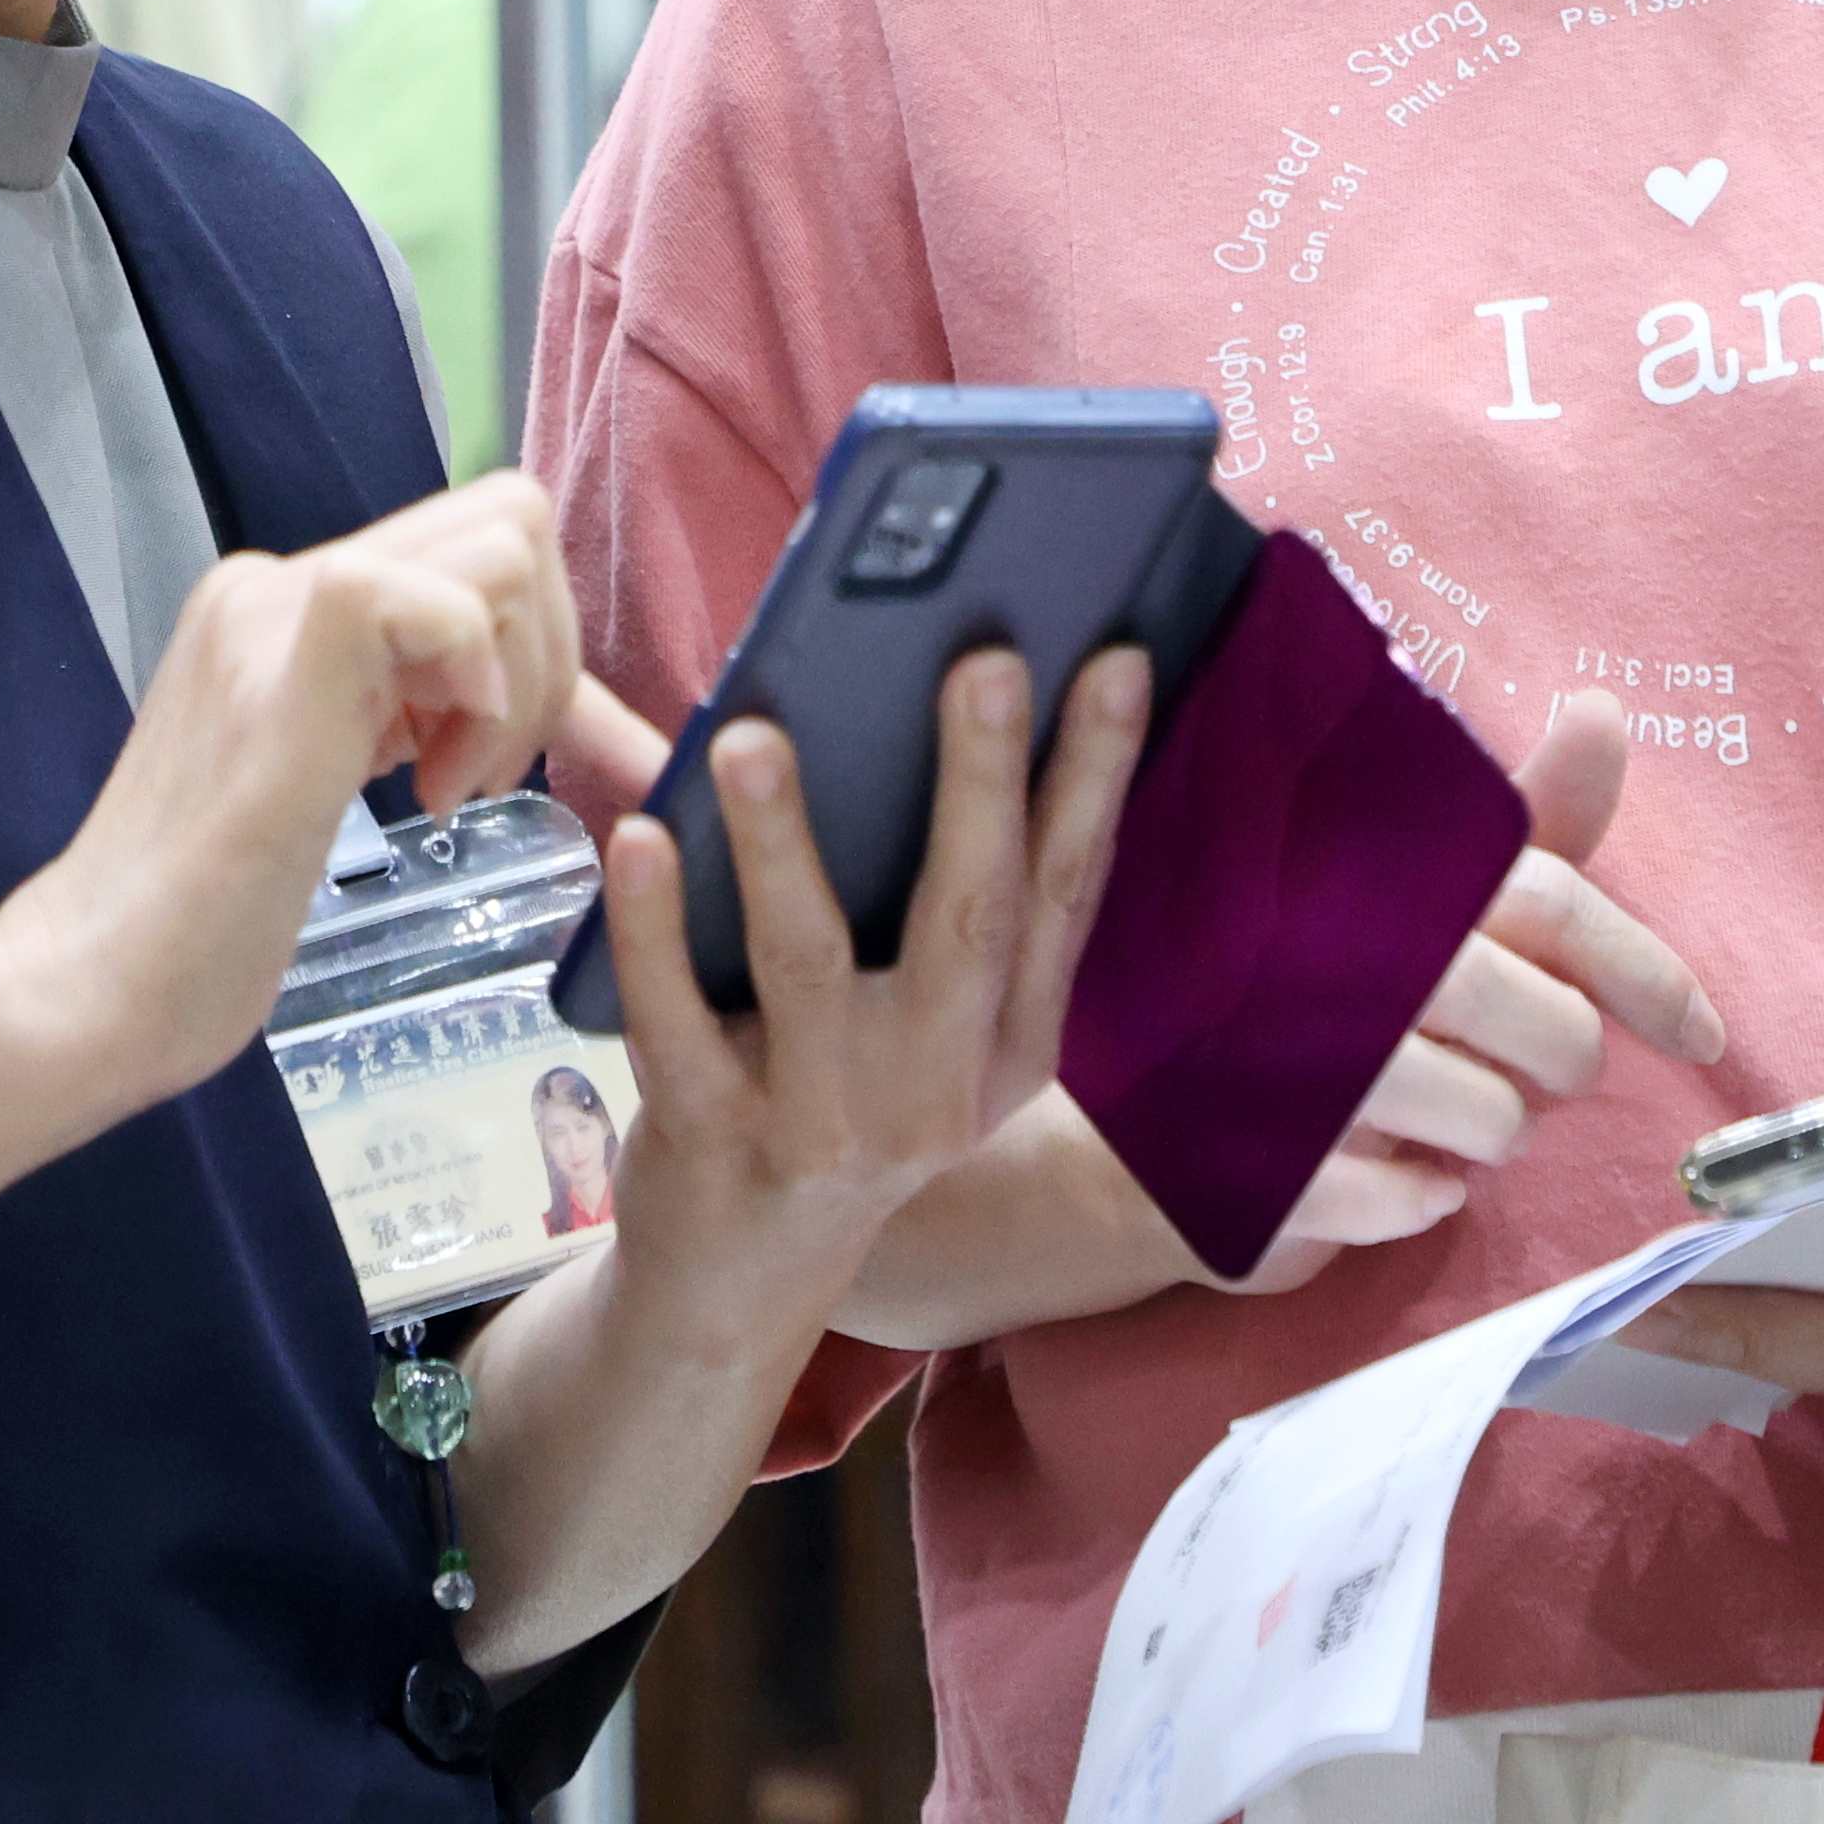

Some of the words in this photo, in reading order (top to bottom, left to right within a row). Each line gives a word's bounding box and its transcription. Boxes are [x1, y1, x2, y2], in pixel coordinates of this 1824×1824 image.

[1561, 5, 1618, 33] Ps.
[1457, 34, 1521, 80] 4:13
[1213, 127, 1321, 273] Created
[1278, 324, 1307, 380] 12:9
[1474, 296, 1562, 421] I
[1206, 338, 1267, 480] Enough
[1343, 508, 1416, 568] 9:37
[1575, 647, 1643, 687] 3:11
[1654, 663, 1734, 695] Eccl.
